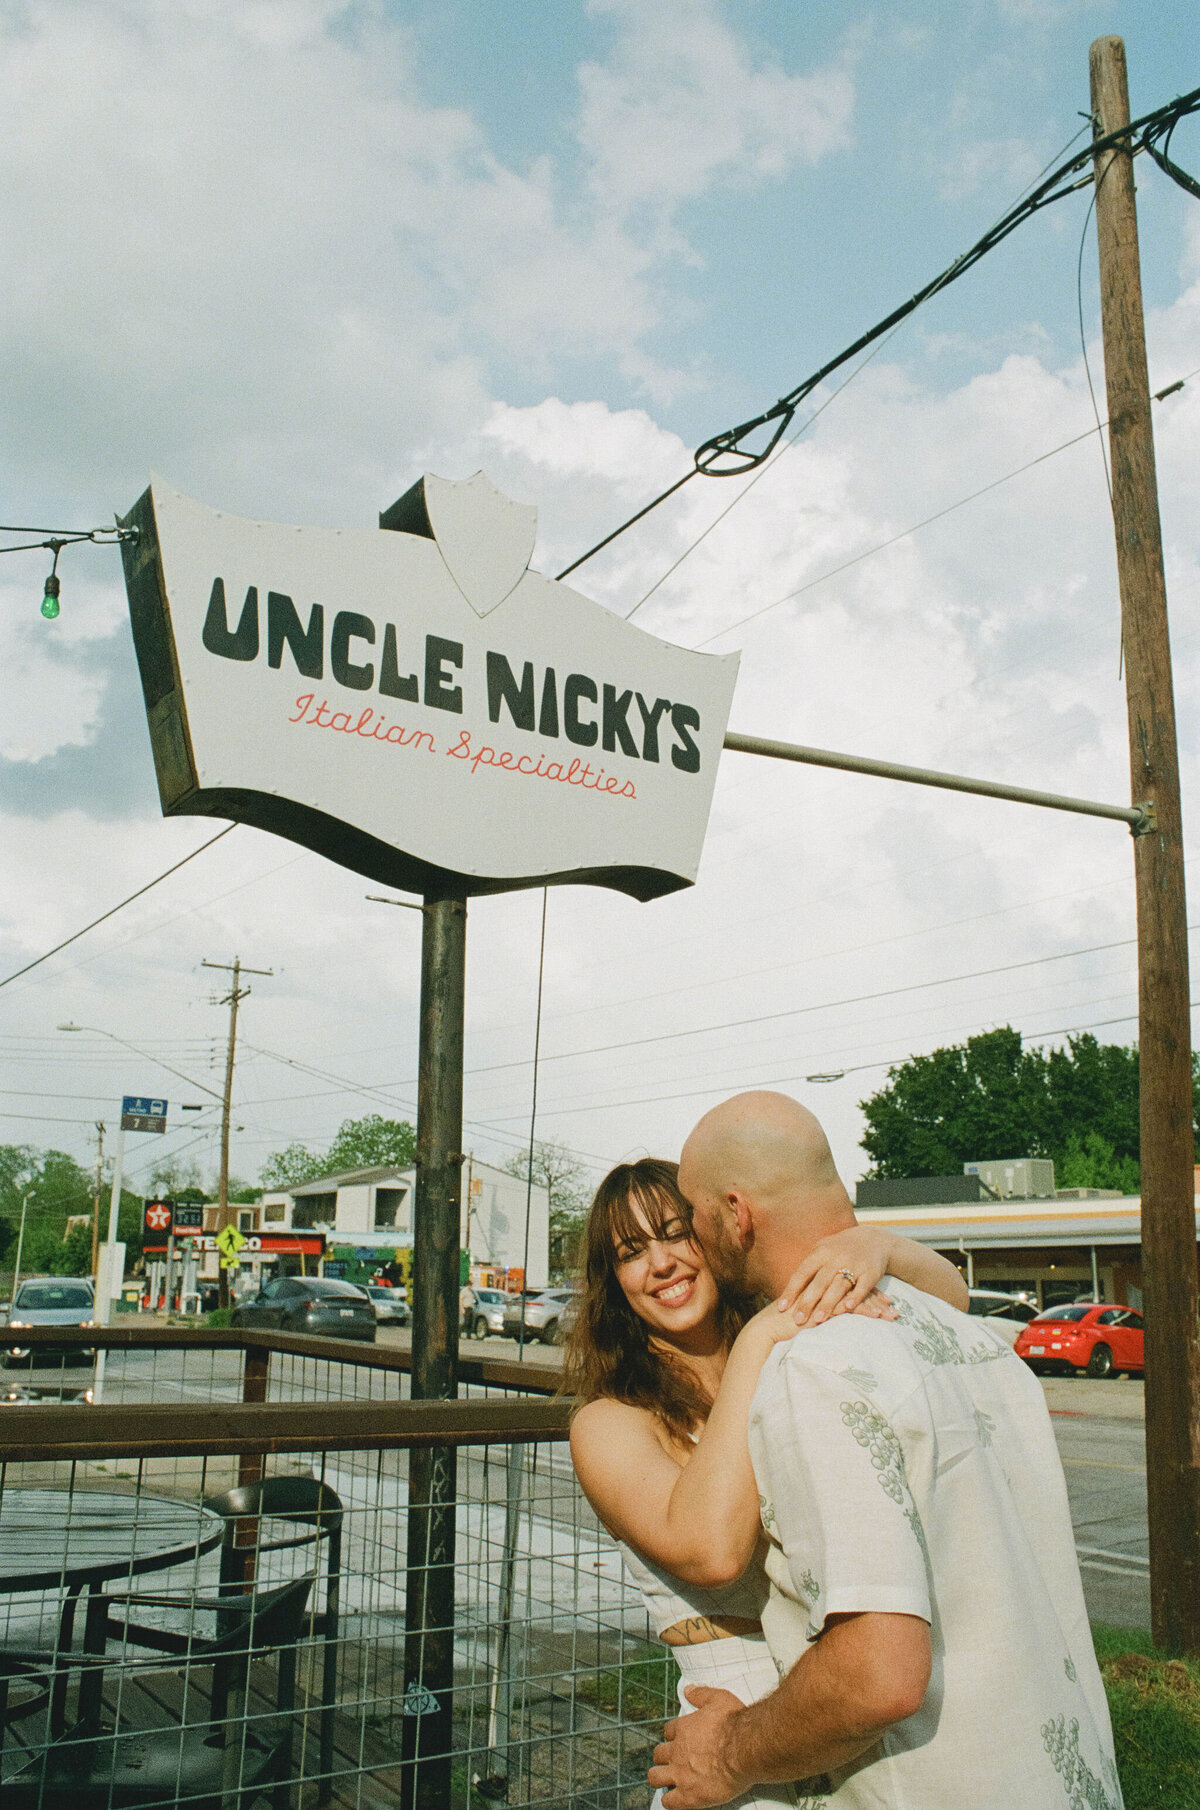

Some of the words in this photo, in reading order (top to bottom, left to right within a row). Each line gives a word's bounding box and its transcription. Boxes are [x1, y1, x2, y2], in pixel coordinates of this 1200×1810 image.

[202, 577, 464, 715] UNCLE
[486, 650, 701, 774] NICKY'S
[288, 693, 436, 753] Italian
[446, 730, 637, 800] Specialties
[133, 1118, 140, 1128] 7
[193, 1236, 261, 1250] TEO
